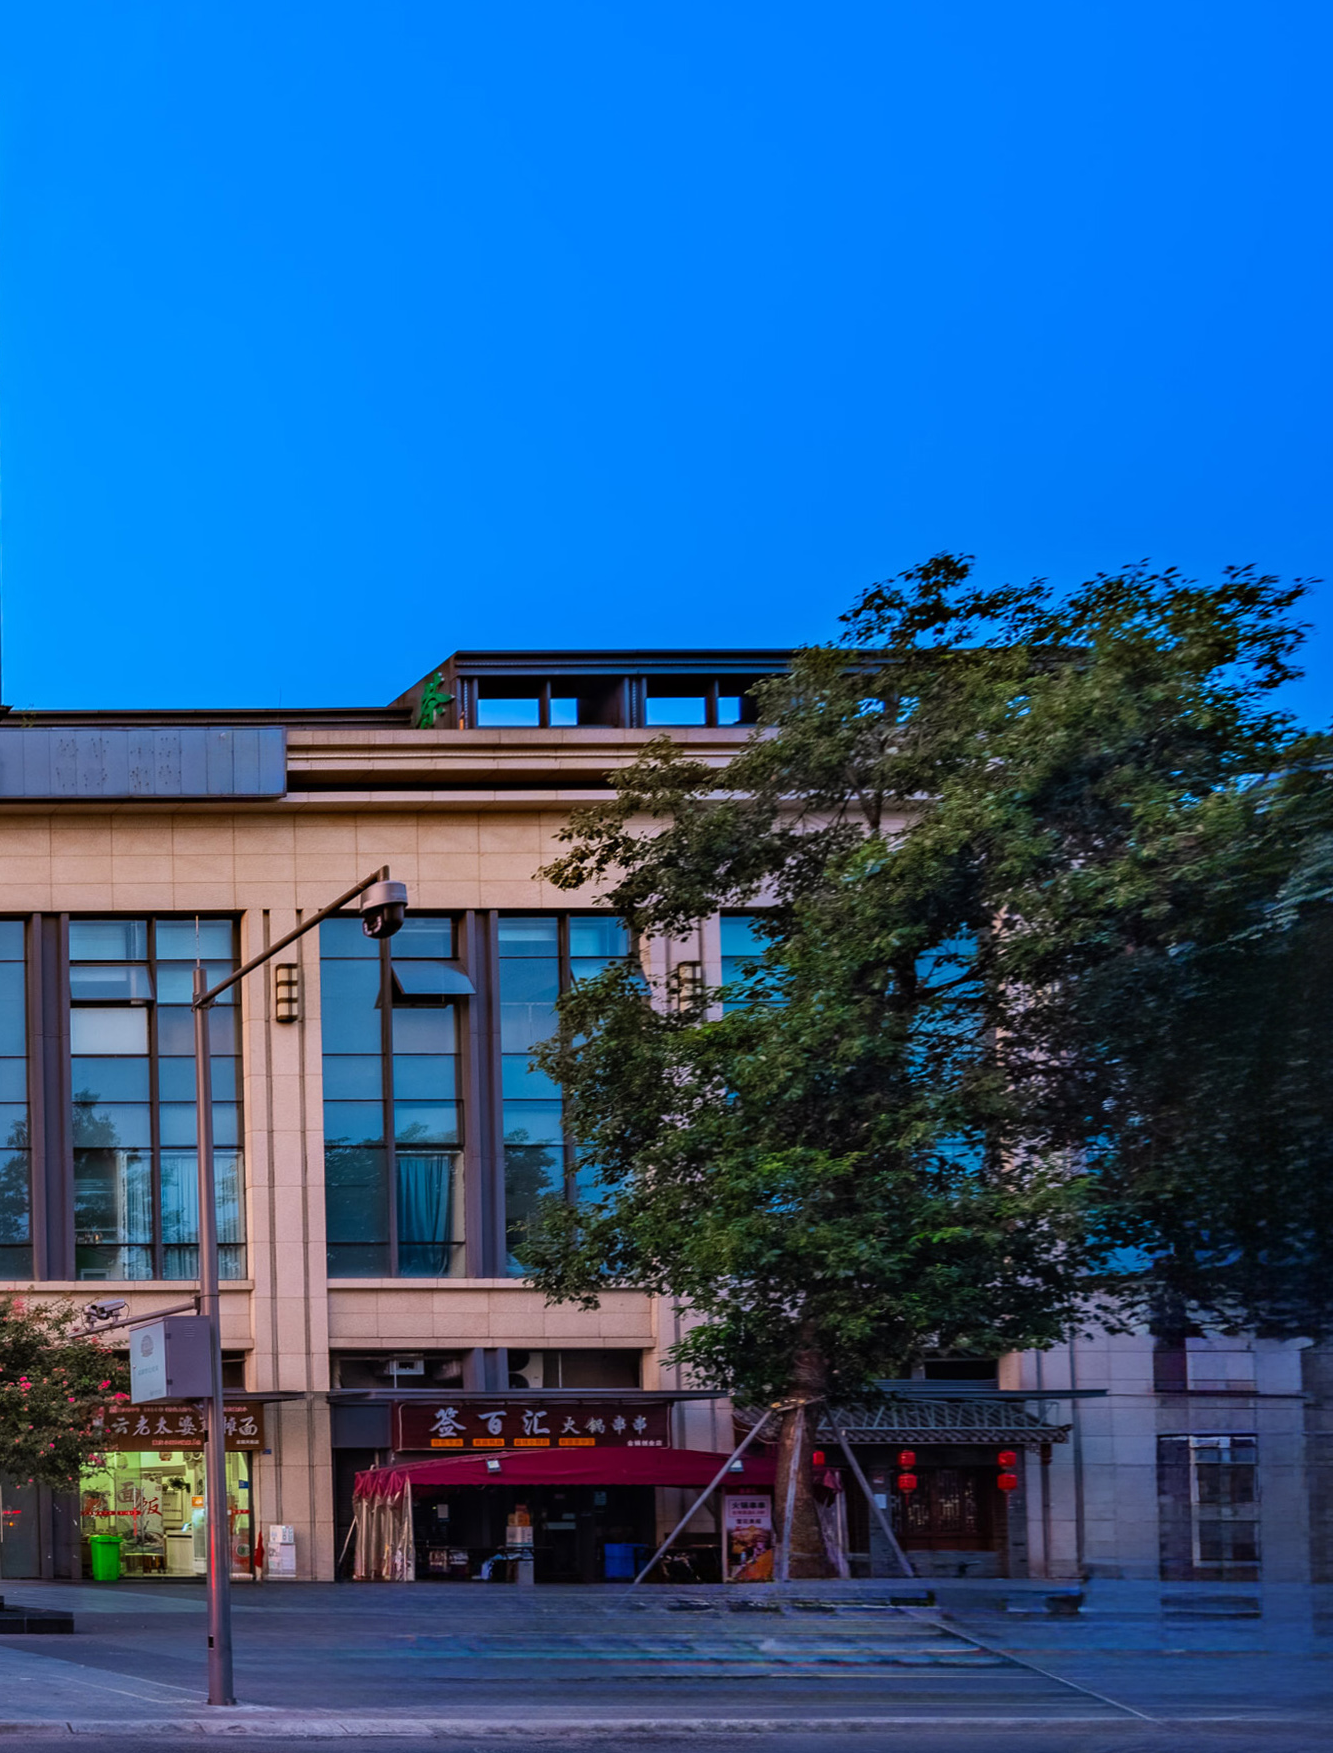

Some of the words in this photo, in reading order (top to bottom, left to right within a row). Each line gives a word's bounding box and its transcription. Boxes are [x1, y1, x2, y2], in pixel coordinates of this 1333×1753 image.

[429, 1407, 551, 1438] 签百汇
[560, 1415, 649, 1435] 火锅串串
